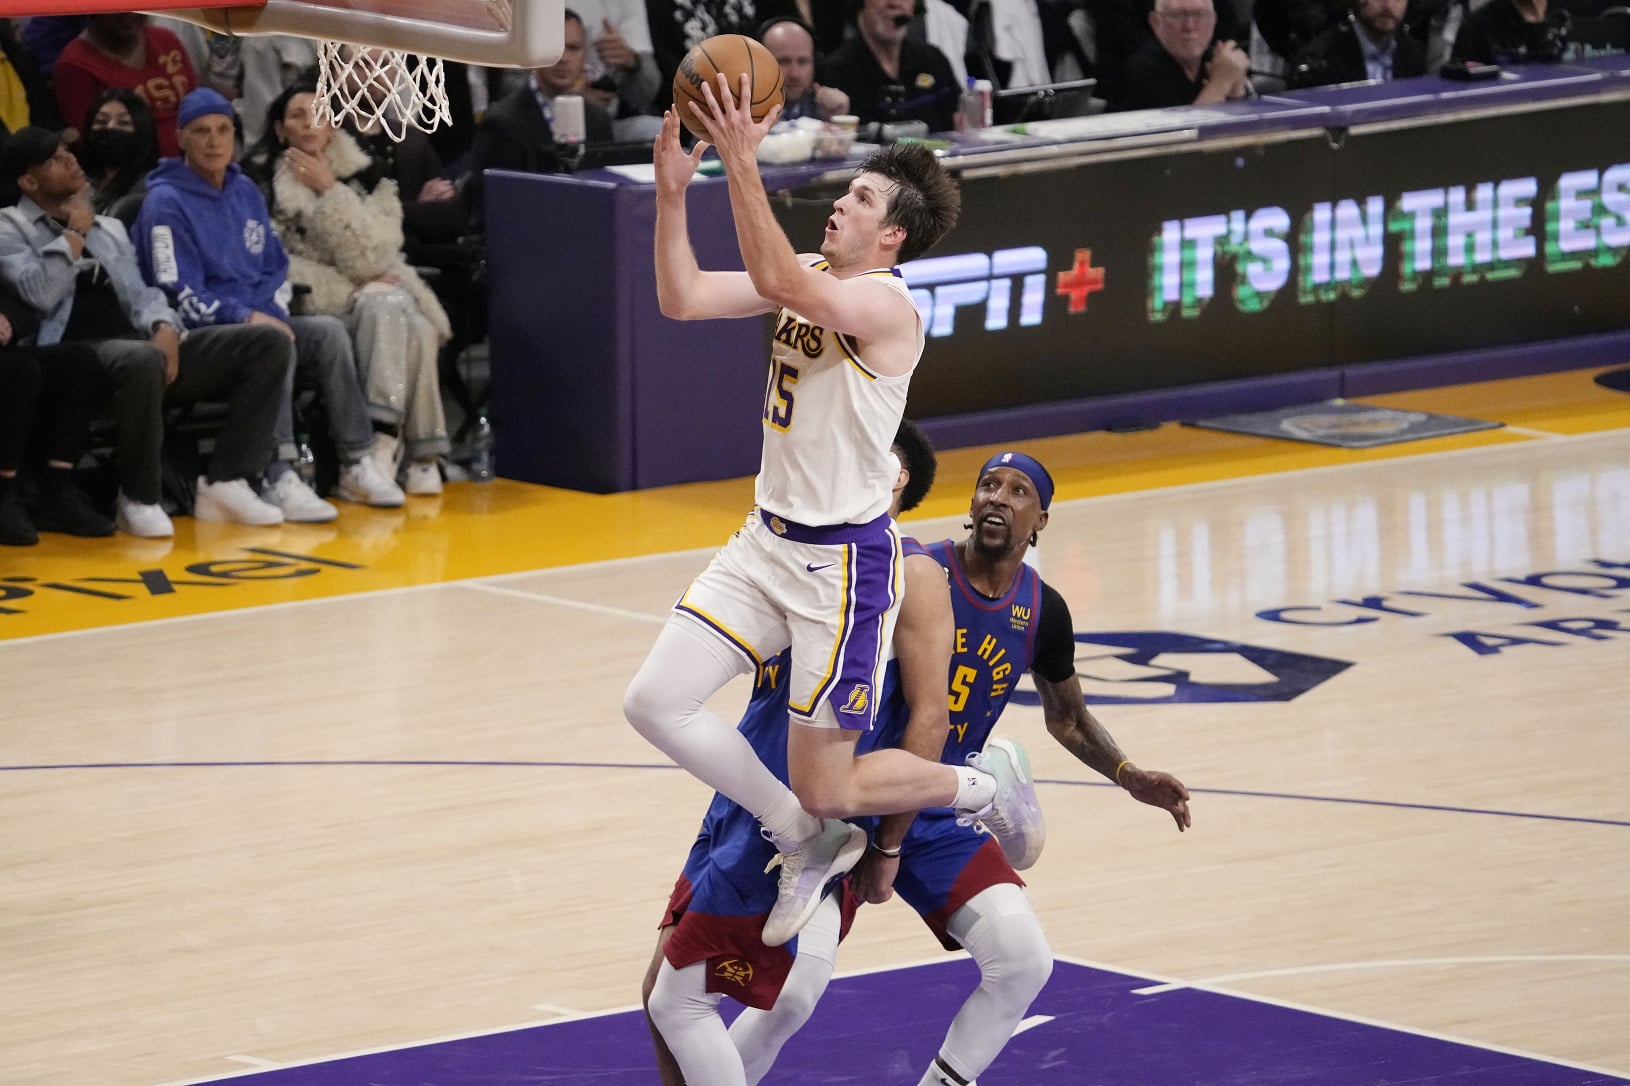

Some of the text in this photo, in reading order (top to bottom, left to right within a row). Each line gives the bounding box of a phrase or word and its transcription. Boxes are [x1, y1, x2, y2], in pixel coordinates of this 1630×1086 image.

[1160, 206, 1292, 303] IT'S
[1312, 195, 1385, 286] IN
[1401, 176, 1539, 273] THE
[1011, 604, 1031, 620] WU
[1428, 608, 1630, 655] AR
[948, 664, 978, 712] 5
[977, 633, 1012, 697] HIGH
